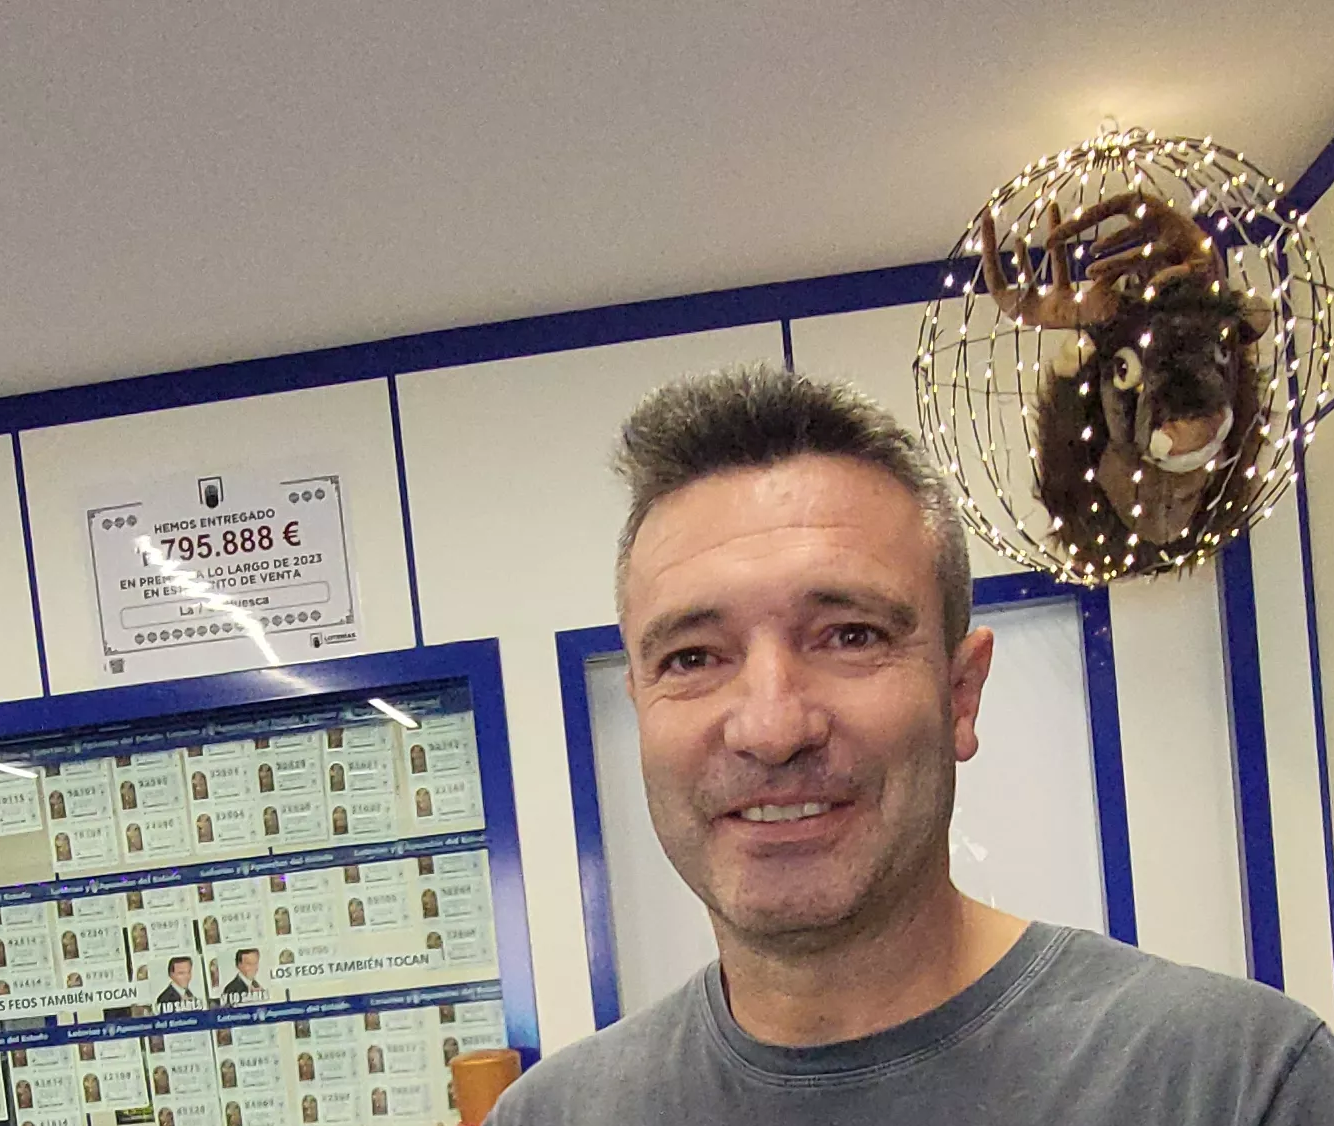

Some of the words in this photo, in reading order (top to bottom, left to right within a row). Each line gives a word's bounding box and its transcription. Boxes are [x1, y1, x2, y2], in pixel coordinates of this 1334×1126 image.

[153, 519, 197, 535] HEMOS
[199, 508, 276, 529] ENTREGADO
[282, 521, 302, 547] €
[120, 578, 136, 590] EN
[208, 565, 224, 578] LO
[228, 559, 270, 575] LARGO
[273, 556, 290, 569] DE
[293, 553, 323, 566] 2023
[143, 588, 160, 600] EN
[241, 573, 258, 586] DE
[260, 569, 303, 583] VENTA
[269, 966, 292, 980] LOS
[295, 963, 327, 978] FEOS
[328, 955, 384, 974] TAMBIÉN
[386, 953, 430, 968] TOCAN
[8, 996, 38, 1011] FEOS
[40, 989, 94, 1007] TAMBIÉN
[95, 987, 138, 1002] TOCAN
